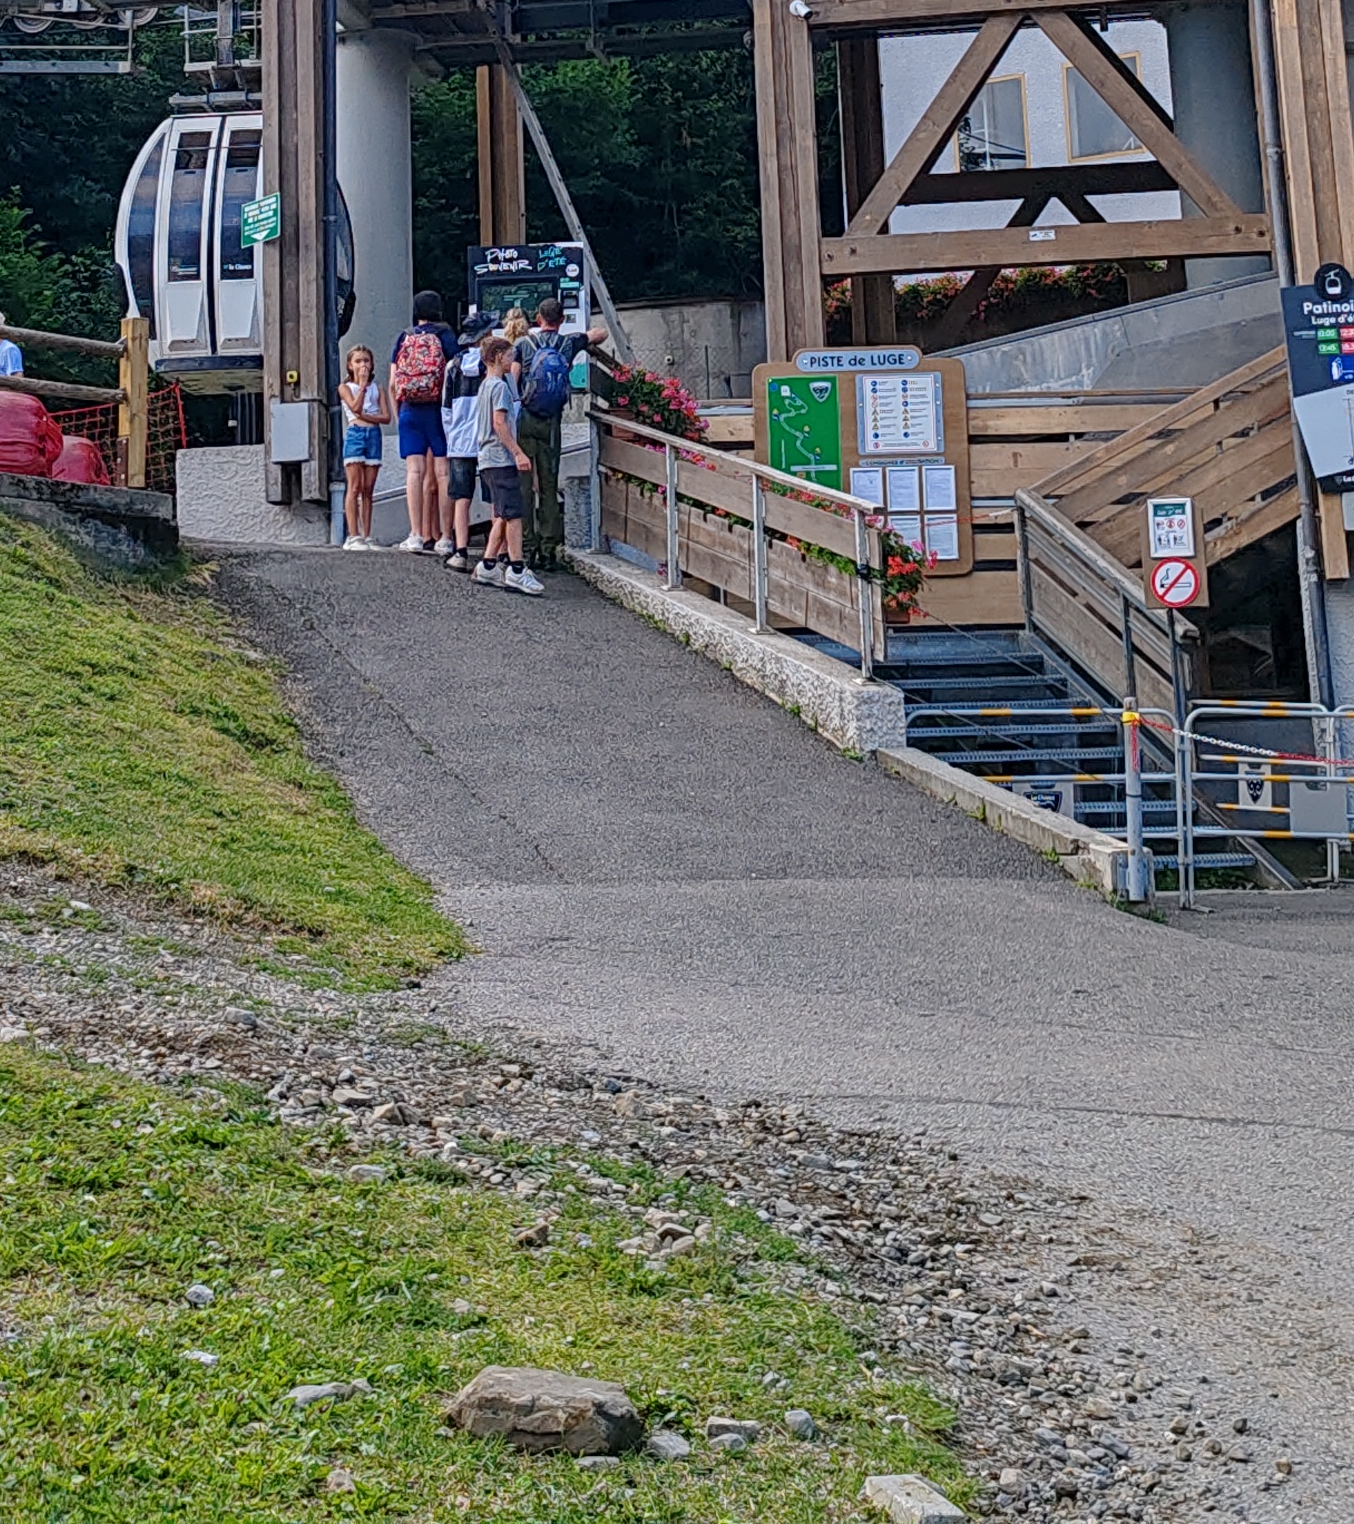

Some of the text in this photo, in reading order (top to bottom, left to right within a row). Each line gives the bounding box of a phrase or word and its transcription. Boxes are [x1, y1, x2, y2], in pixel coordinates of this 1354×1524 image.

[1311, 316, 1336, 326] Luge
[810, 353, 905, 368] PISTE de LUGE
